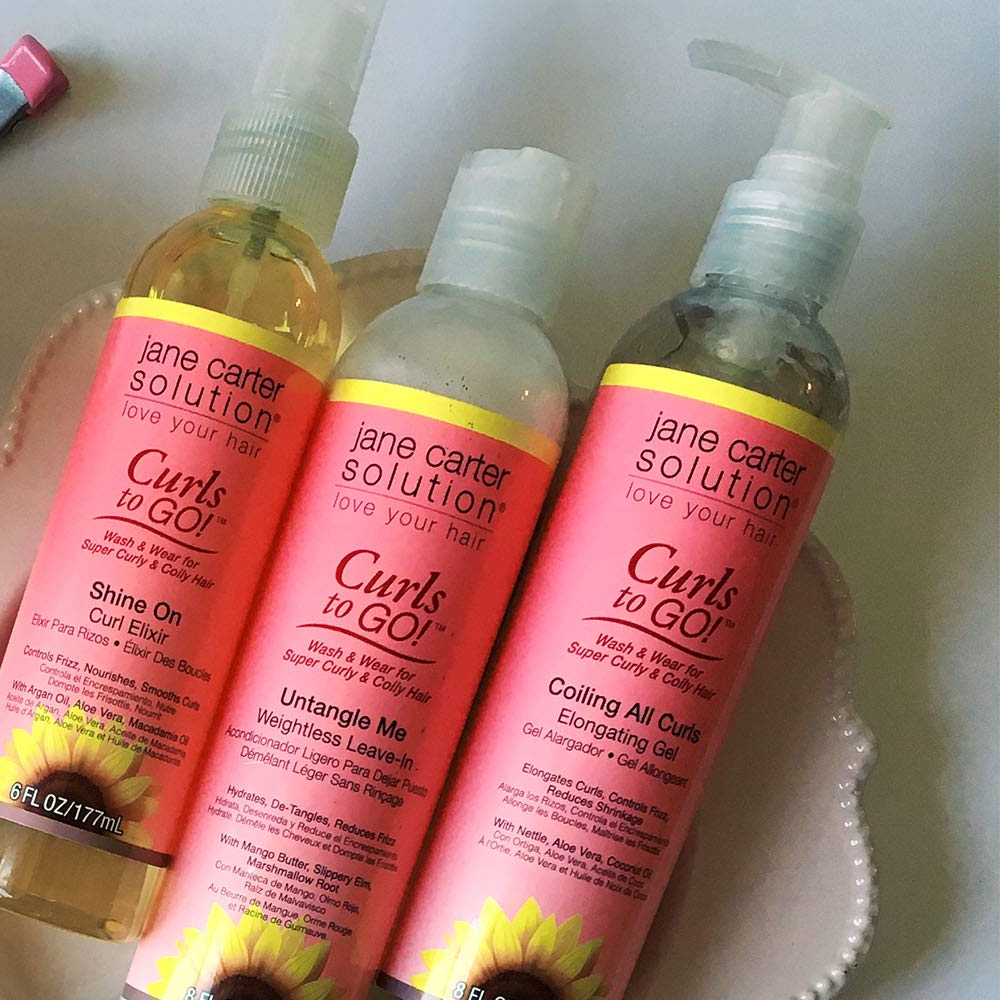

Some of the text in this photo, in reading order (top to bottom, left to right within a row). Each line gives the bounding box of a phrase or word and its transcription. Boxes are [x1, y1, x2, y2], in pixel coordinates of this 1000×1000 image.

[136, 334, 285, 402] jane carter
[349, 420, 511, 490] jane carter
[644, 410, 806, 483] jane carter
[115, 487, 144, 511] to
[126, 448, 226, 508] Curls
[80, 538, 115, 556] Super
[115, 547, 149, 568] Curly
[148, 559, 159, 571] &
[190, 573, 215, 589] Hair
[103, 529, 200, 569] Wash & Wear for
[627, 542, 738, 610] Curls
[89, 580, 182, 627] Shine On
[321, 592, 354, 618] to
[334, 548, 446, 614] Curls
[611, 585, 647, 613] to
[88, 606, 169, 645] Curl Elixir
[23, 644, 54, 662] Controls
[139, 680, 181, 704] Smooths
[282, 648, 321, 668] Super
[321, 659, 359, 681] Curly
[358, 671, 370, 684] &
[404, 685, 432, 703] Hair
[307, 639, 416, 682] Wash & Wear for
[566, 640, 609, 662] Super
[609, 654, 649, 677] Curly
[648, 667, 660, 680] &
[691, 682, 717, 701] Hair
[595, 632, 704, 679] Wash & Wear for
[279, 686, 407, 742] Untangle Me
[548, 676, 701, 744] Coiling All Curls
[556, 707, 680, 762] Elongating Gel
[256, 707, 413, 770] Weightless Leave-In
[10, 782, 22, 800] 6
[21, 785, 40, 808] FL
[226, 784, 267, 807] Hydrates,
[332, 817, 376, 840] Reduces
